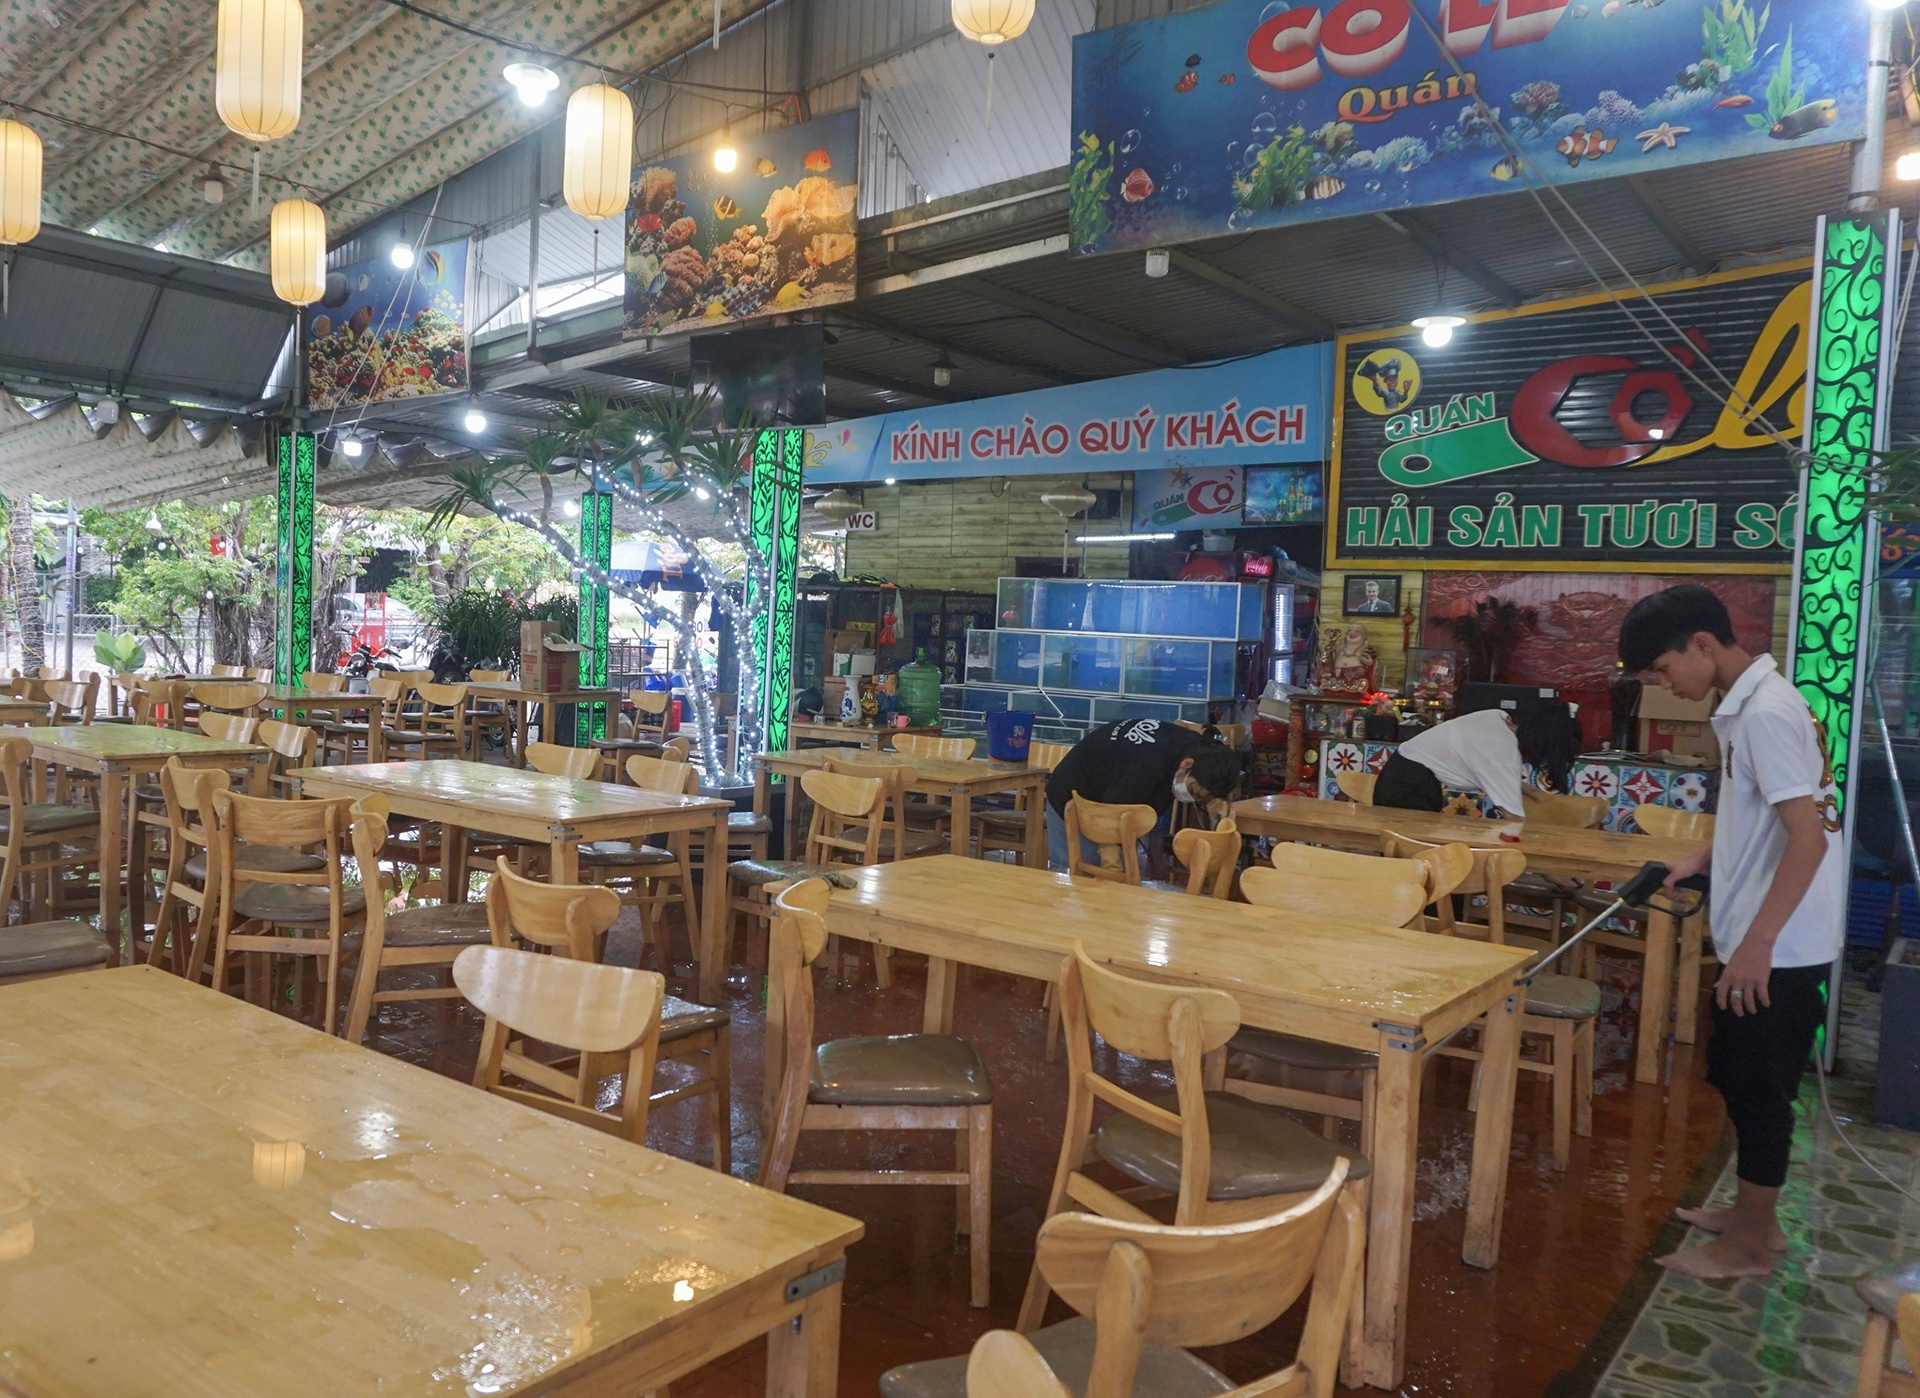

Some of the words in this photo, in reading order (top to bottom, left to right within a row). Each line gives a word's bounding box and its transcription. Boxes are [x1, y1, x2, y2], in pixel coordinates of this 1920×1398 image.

[1335, 69, 1477, 125] Quán
[891, 421, 961, 462] KÍNH
[969, 414, 1070, 458] CHÀO
[1080, 404, 1159, 454] QUÝ
[1164, 398, 1305, 450] KHÁCH
[1384, 391, 1496, 441] QUÁN
[848, 514, 873, 528] WC
[1153, 493, 1184, 510] QUÁN
[1346, 493, 1432, 547] HẢI
[1447, 493, 1562, 547] SẢN
[1578, 499, 1717, 548] TƯƠI
